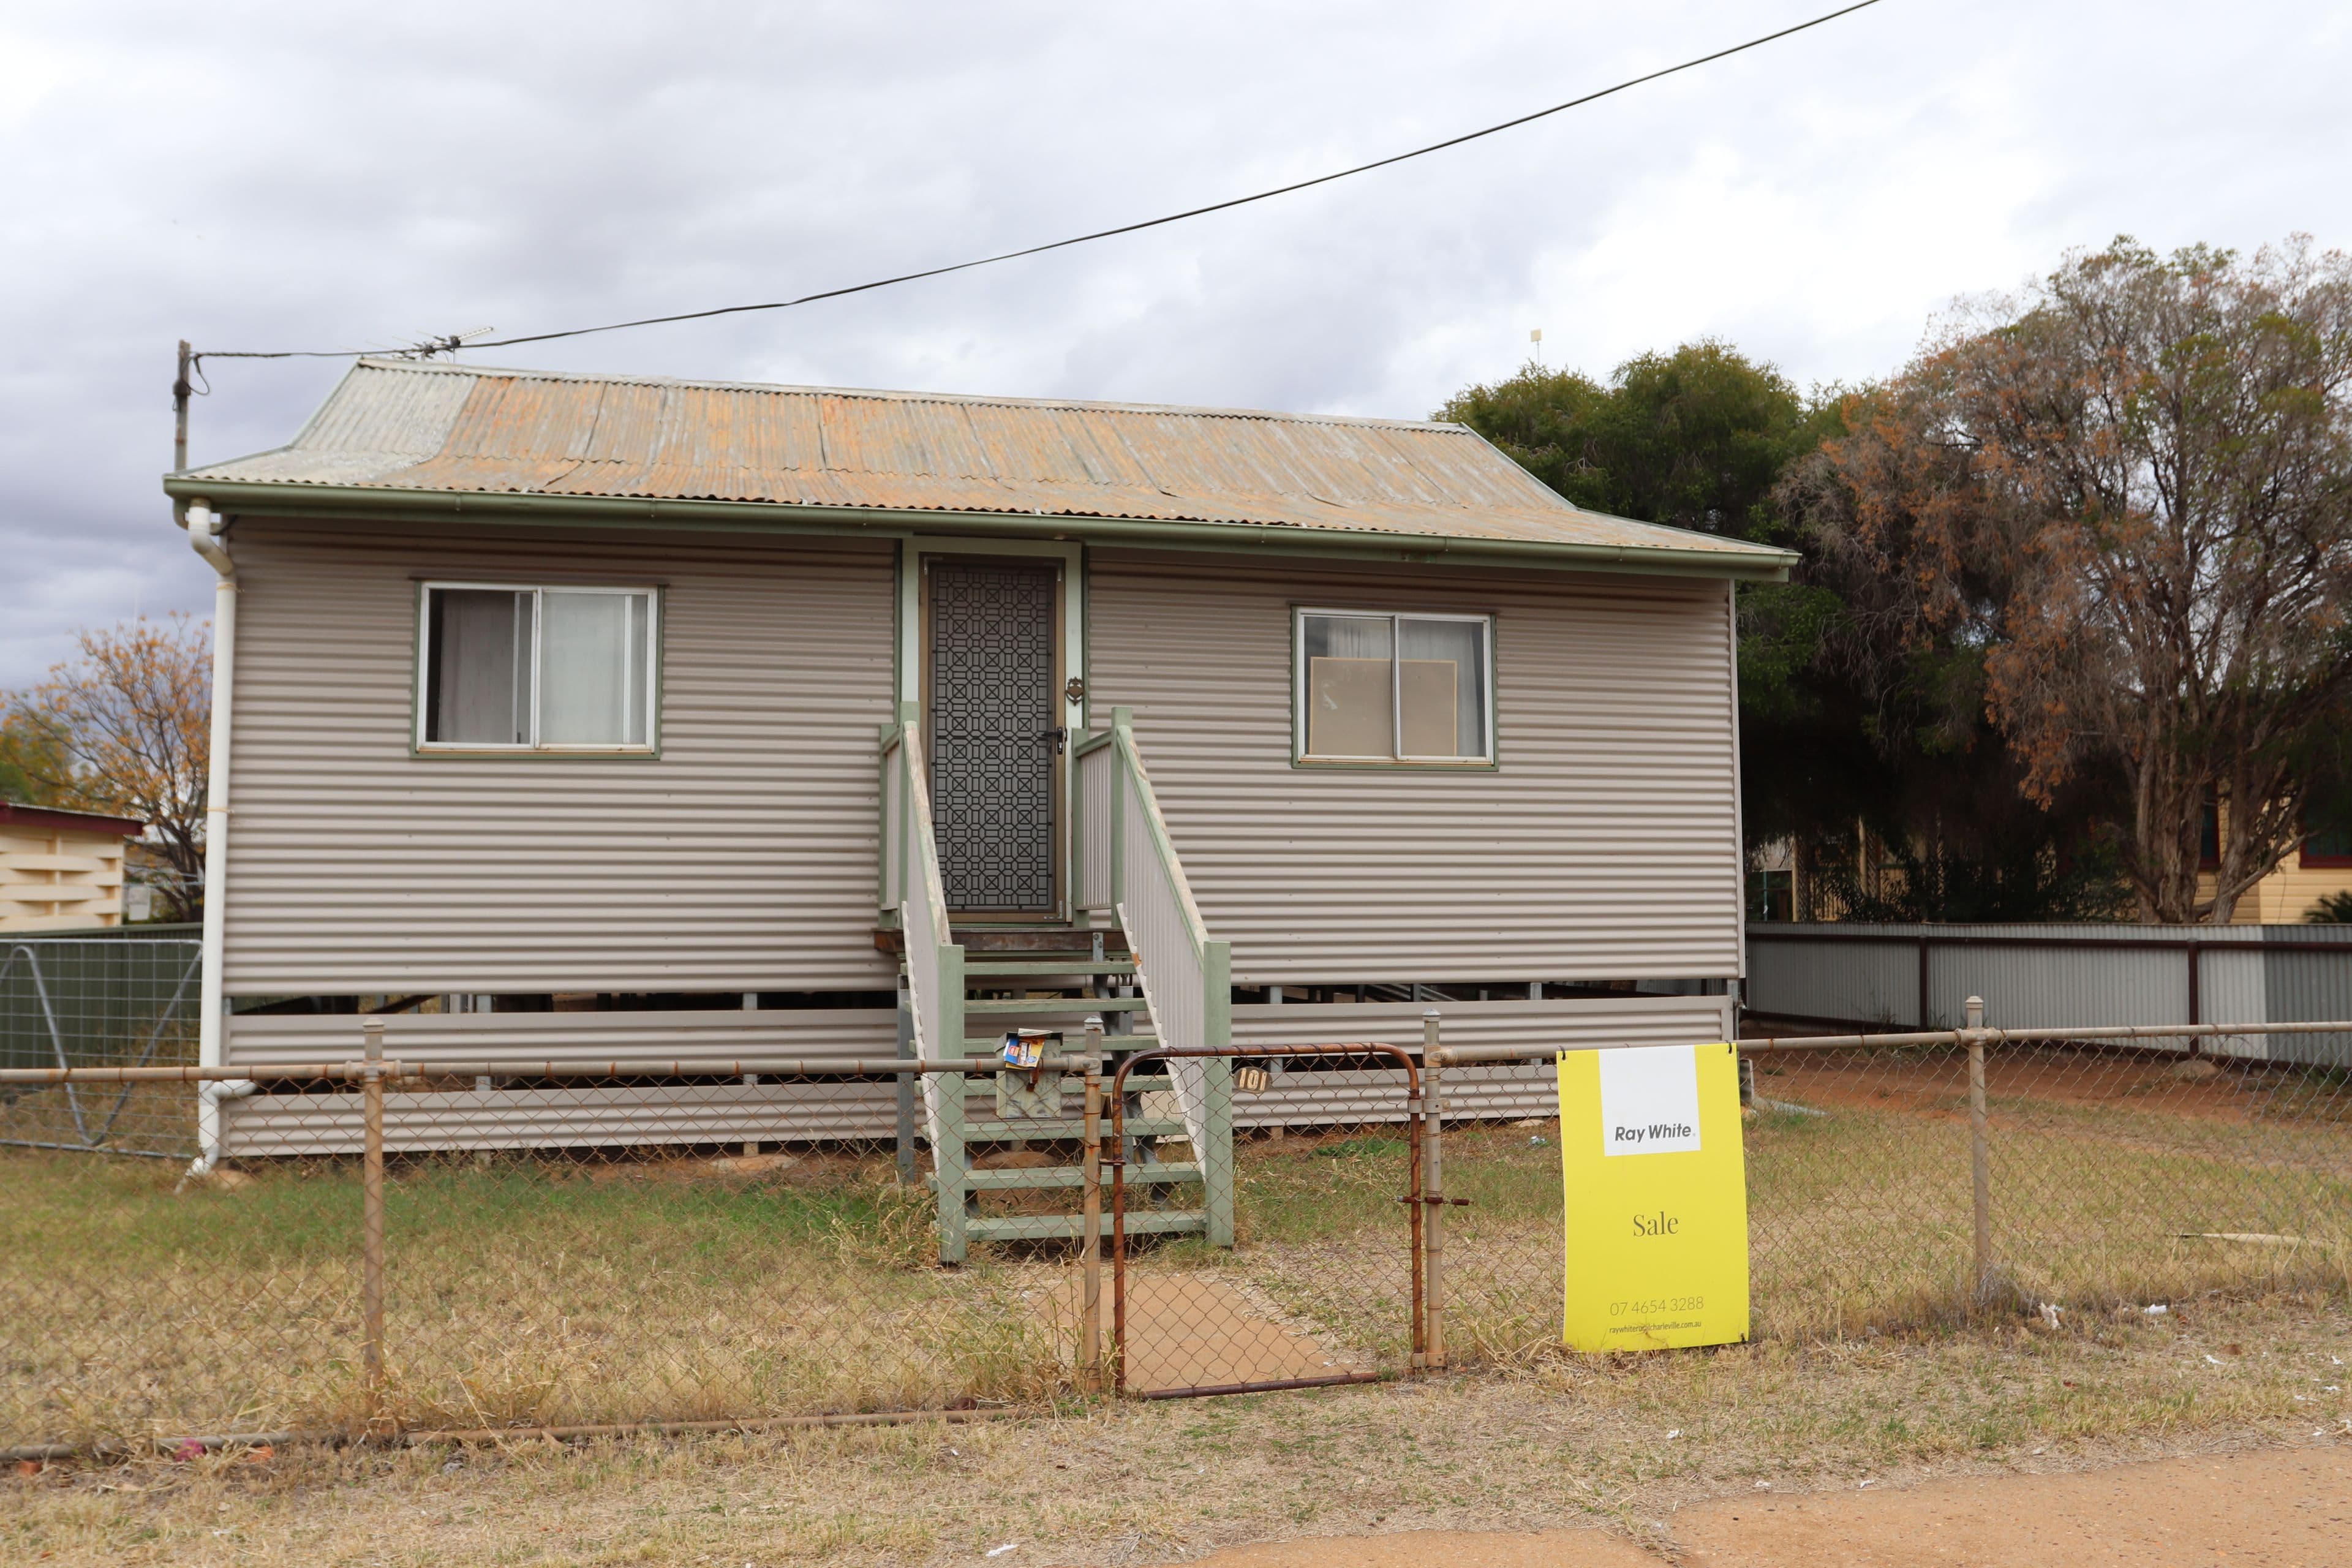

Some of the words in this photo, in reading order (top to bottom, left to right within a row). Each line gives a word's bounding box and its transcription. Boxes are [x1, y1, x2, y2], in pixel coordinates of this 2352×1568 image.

[1615, 1126, 1645, 1143] Ray
[1648, 1123, 1692, 1139] White
[1633, 1210, 1679, 1237] Sale
[1610, 1302, 1628, 1316] 07
[1631, 1299, 1666, 1314] 4654
[1670, 1296, 1704, 1312] 3288
